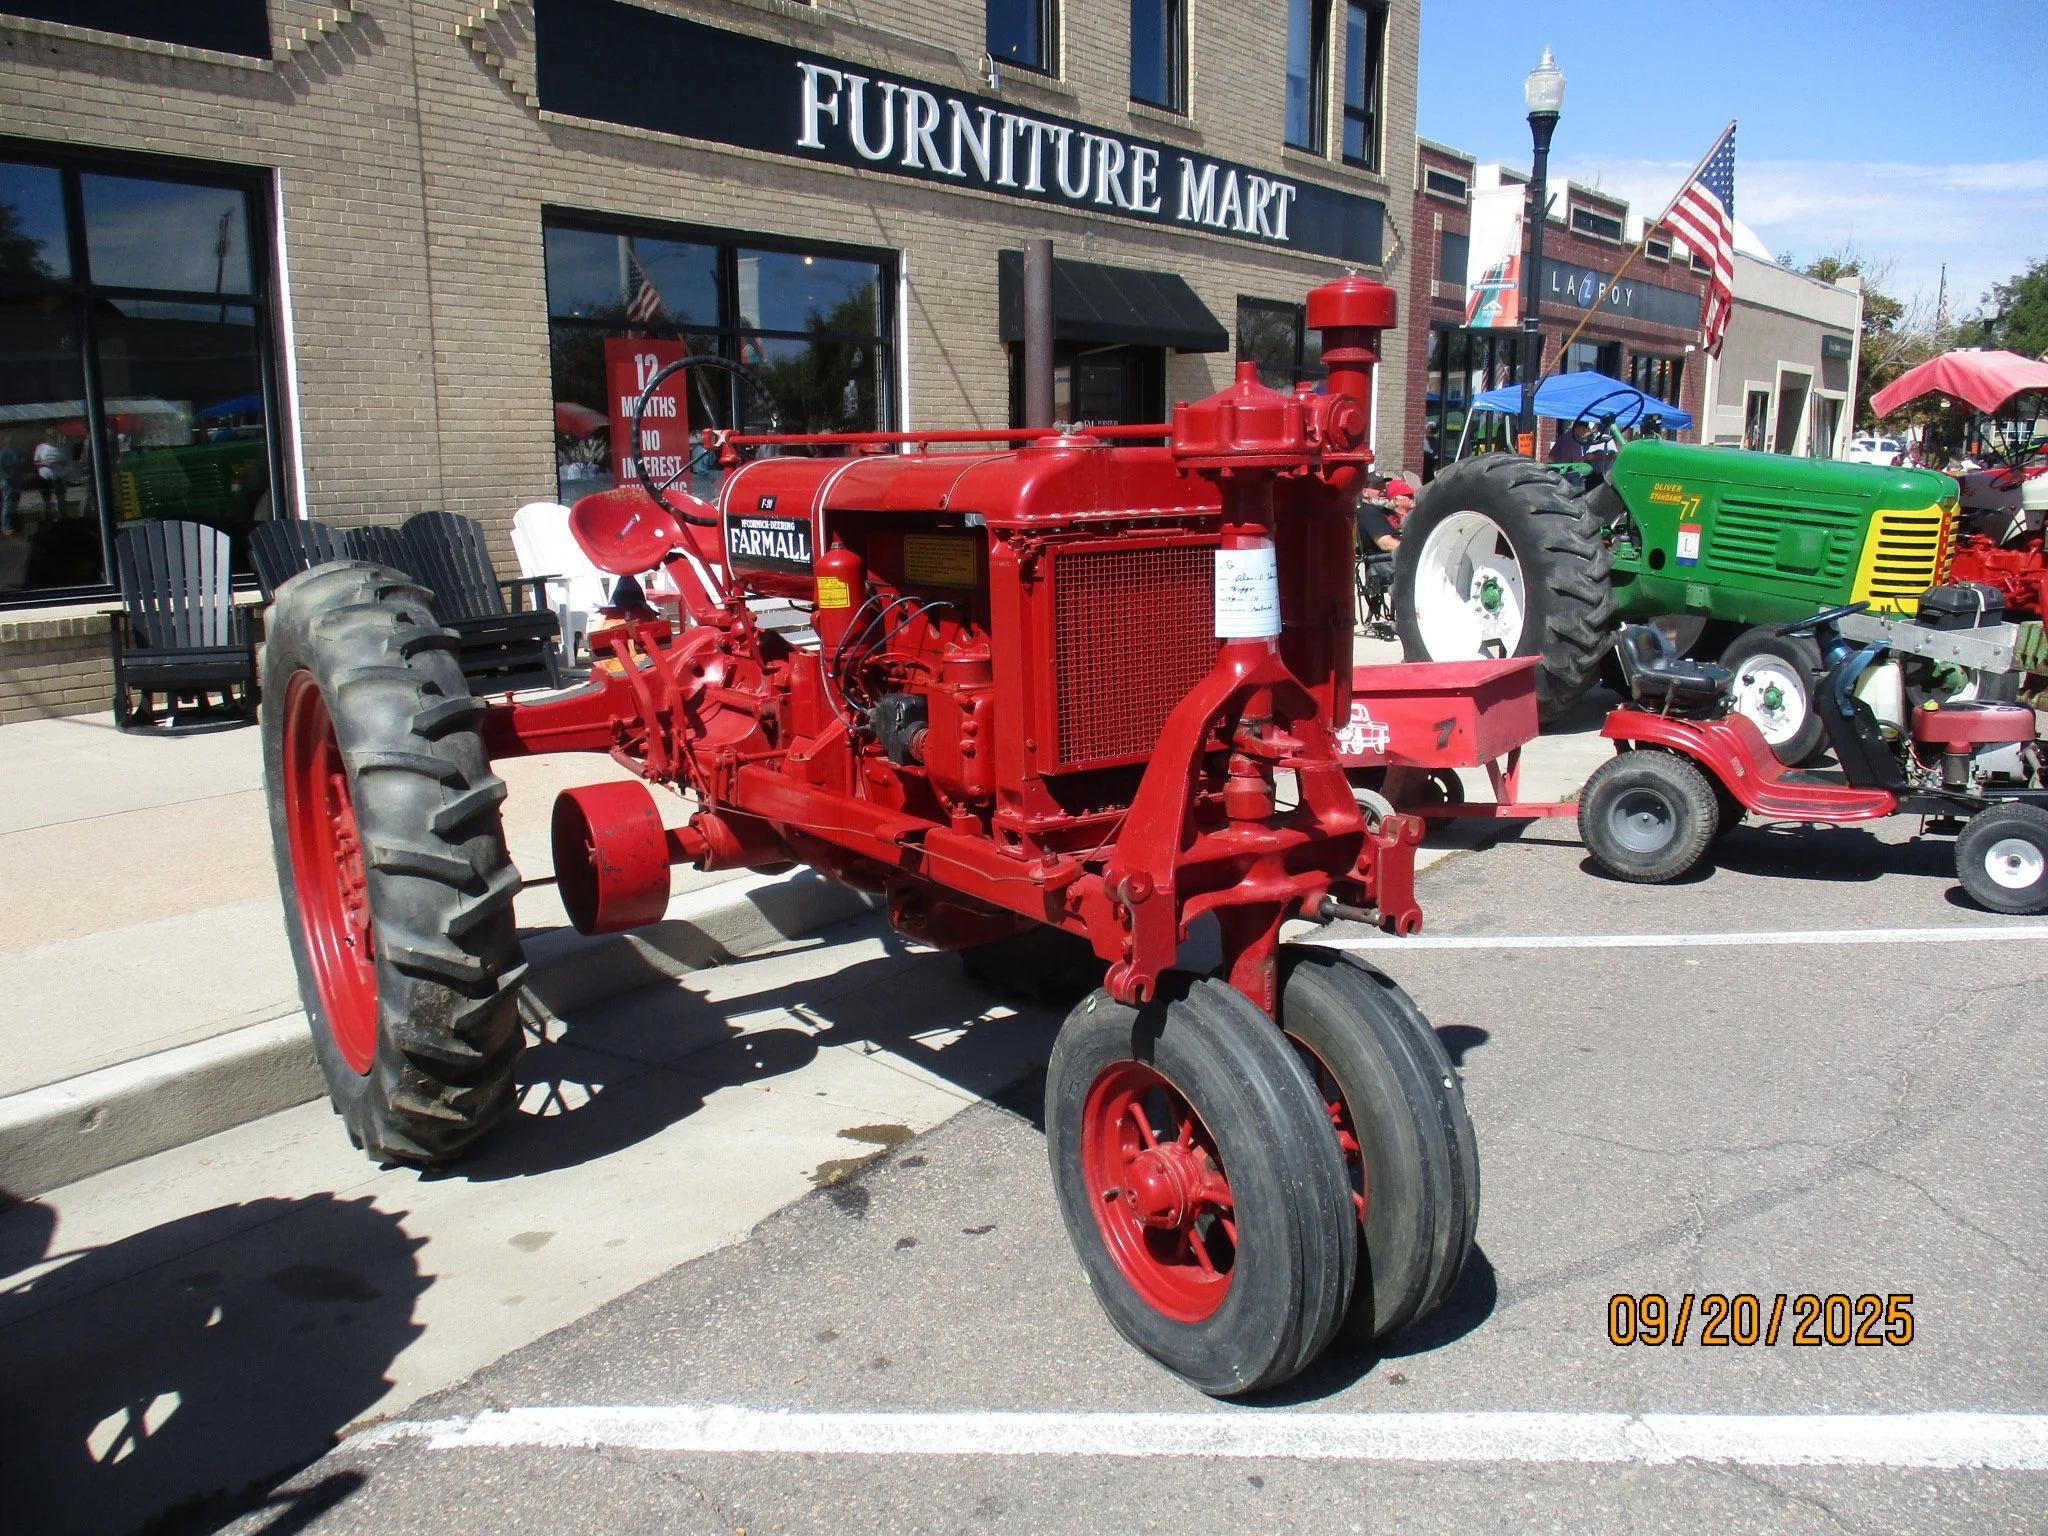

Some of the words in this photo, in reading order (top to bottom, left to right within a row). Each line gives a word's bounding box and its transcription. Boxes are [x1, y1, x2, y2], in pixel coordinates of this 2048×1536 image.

[796, 61, 1162, 214] FURNITURE
[1178, 156, 1296, 241] MART
[634, 353, 660, 391] 12
[641, 430, 661, 451] NO
[622, 456, 682, 479] INEREST
[1649, 493, 1682, 502] STANDARD
[1654, 483, 1682, 492] OLIVER
[1680, 497, 1701, 520] 77
[730, 528, 811, 561] FARMALL
